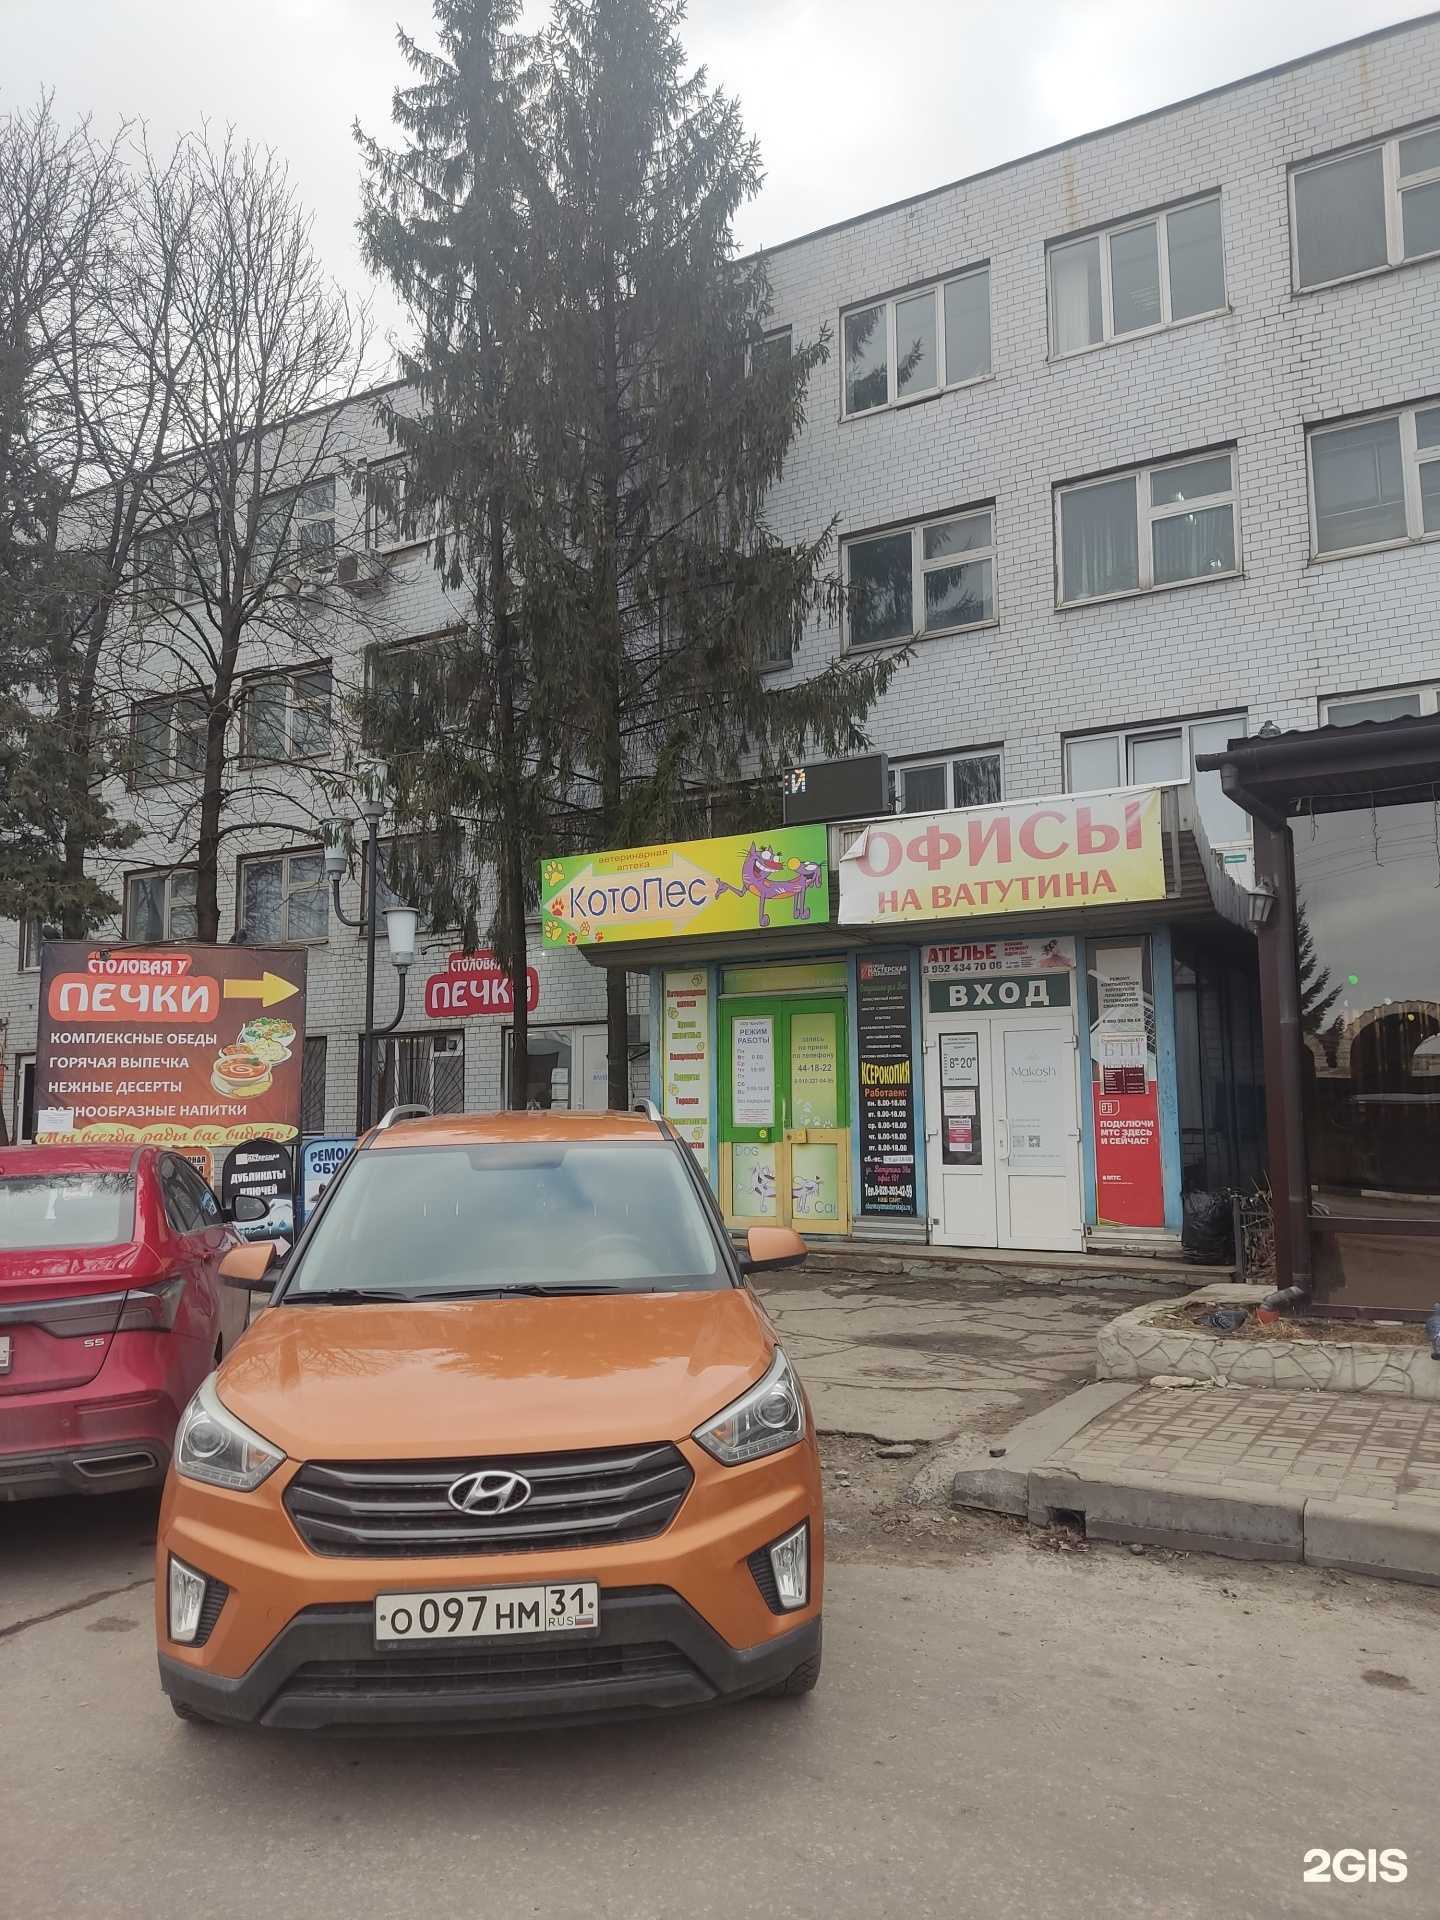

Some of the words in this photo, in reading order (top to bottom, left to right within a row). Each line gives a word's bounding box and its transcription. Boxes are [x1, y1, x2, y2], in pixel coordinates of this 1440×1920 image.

[853, 800, 1143, 878] ОФИСЫ
[616, 861, 650, 872] аптека
[570, 877, 708, 918] КотоПес
[877, 888, 923, 914] НА
[931, 868, 1117, 909] ВАТУТИНА
[927, 944, 997, 963] АТЕЛЬЕ
[88, 959, 172, 975] СТОЛОВАЯ
[176, 960, 188, 975] У
[450, 957, 504, 973] СТОЛОВА
[952, 964, 971, 972] 434
[975, 962, 987, 971] 70
[59, 983, 210, 1013] ПЕЧКИ
[949, 980, 1050, 1007] ВХОД
[51, 1032, 163, 1045] КОМПЛЕКСНЫЕ
[167, 1033, 217, 1047] ОБЕДЫ
[737, 1036, 770, 1045] РАБОТЫ
[50, 1057, 117, 1068] ГОРЯЧАЯ
[121, 1057, 189, 1068] ВЫПЕЧКА
[861, 1061, 910, 1085] КСЕРОКОПИЯ
[48, 1082, 113, 1093] НЕЖНЫЕ
[116, 1081, 182, 1094] ДЕСЕРТЫ
[865, 1088, 907, 1098] Работаем:
[48, 1105, 176, 1117] НООБРАЗНЫЕ
[180, 1104, 247, 1116] НАПИТКИ
[1100, 1120, 1154, 1128] ПОДКЛЮЧИ
[1122, 1129, 1152, 1137] ЗДЕСЬ
[1109, 1136, 1149, 1144] СЕЙЧАС!
[313, 1162, 340, 1174] ОБУ
[550, 1588, 584, 1615] 31
[549, 1616, 574, 1626] RUS
